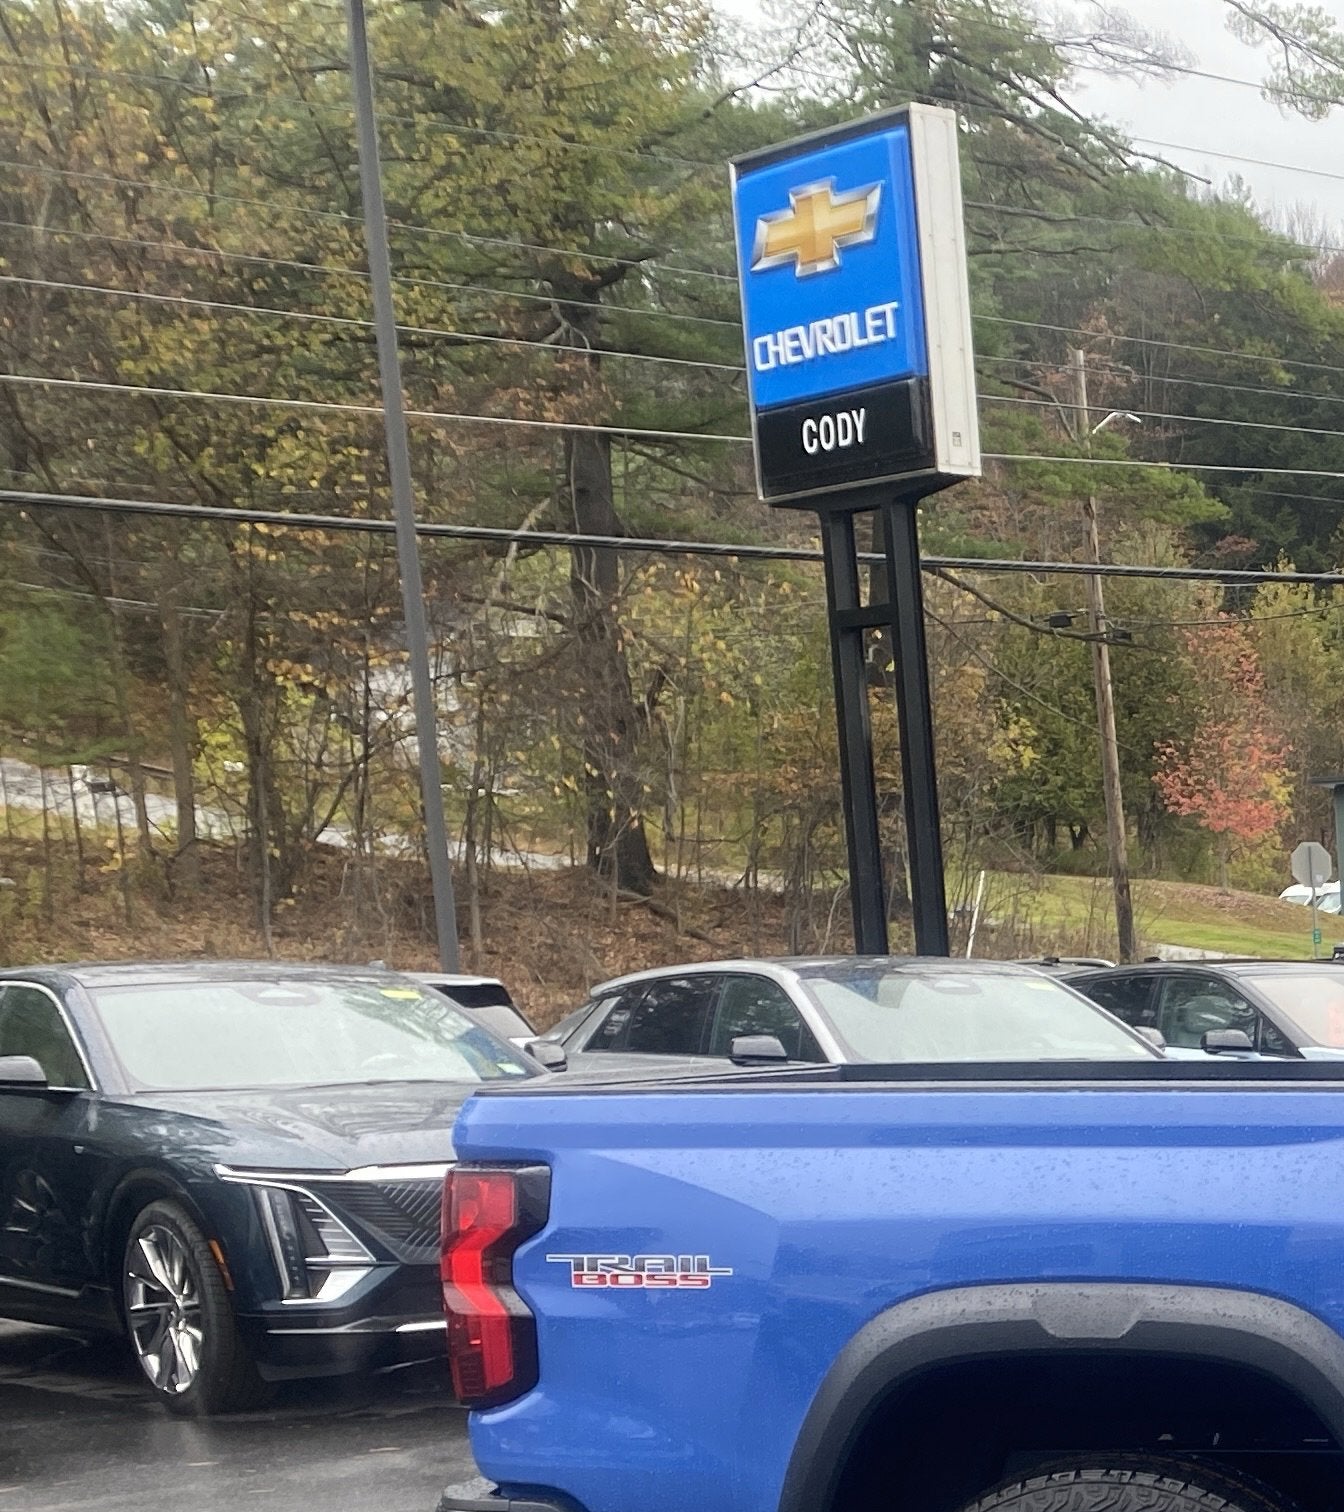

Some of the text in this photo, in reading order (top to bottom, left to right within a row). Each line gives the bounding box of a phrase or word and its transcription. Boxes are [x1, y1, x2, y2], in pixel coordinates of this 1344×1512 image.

[753, 301, 898, 371] CHEVROLET
[802, 408, 866, 454] CODY
[546, 1254, 733, 1275] TRAIL
[572, 1273, 711, 1289] BOSS
